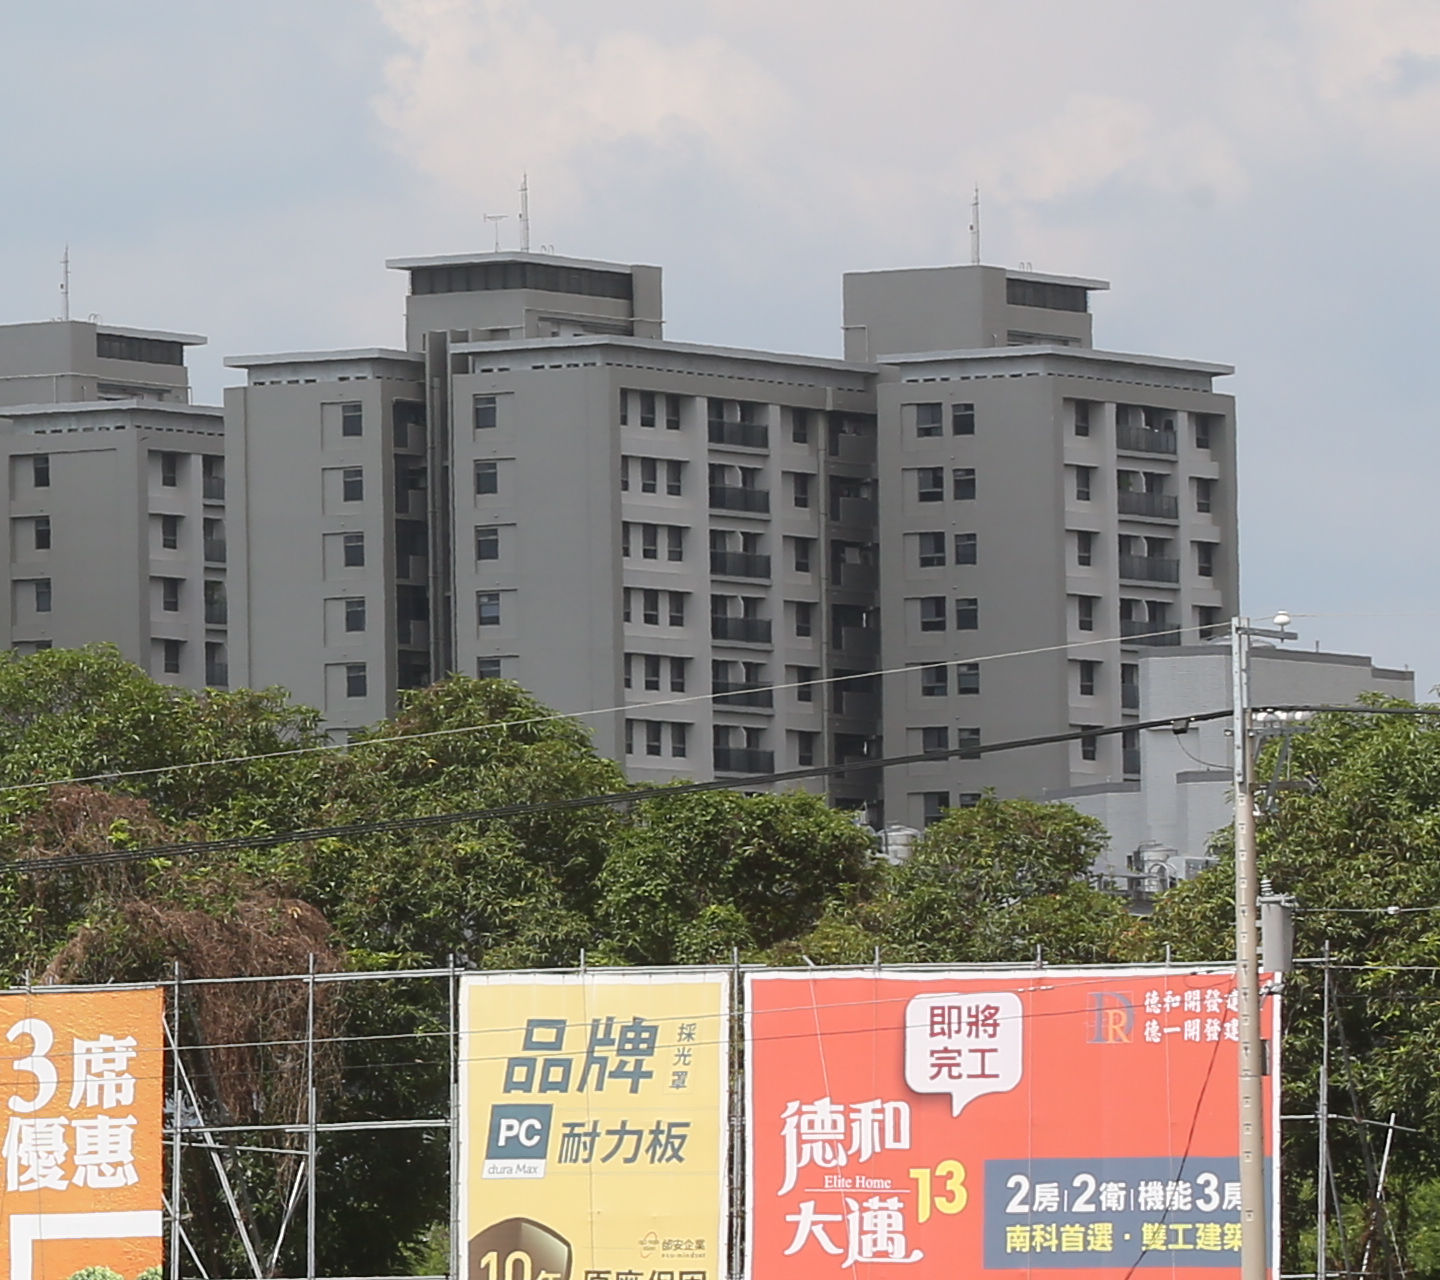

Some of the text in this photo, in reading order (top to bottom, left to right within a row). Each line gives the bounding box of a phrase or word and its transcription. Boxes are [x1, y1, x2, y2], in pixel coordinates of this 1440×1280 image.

[929, 1004, 1000, 1039] 即將
[1143, 989, 1240, 1014] 德和開發建
[1143, 1019, 1240, 1043] 德一開發建
[503, 1017, 659, 1093] 品牌
[669, 1022, 697, 1089] 採光罩
[929, 1047, 1000, 1080] 完工
[498, 1119, 691, 1164] PC 耐力板
[778, 1096, 911, 1196] 德和
[824, 1175, 892, 1189] Elite Home
[909, 1159, 968, 1223] 13
